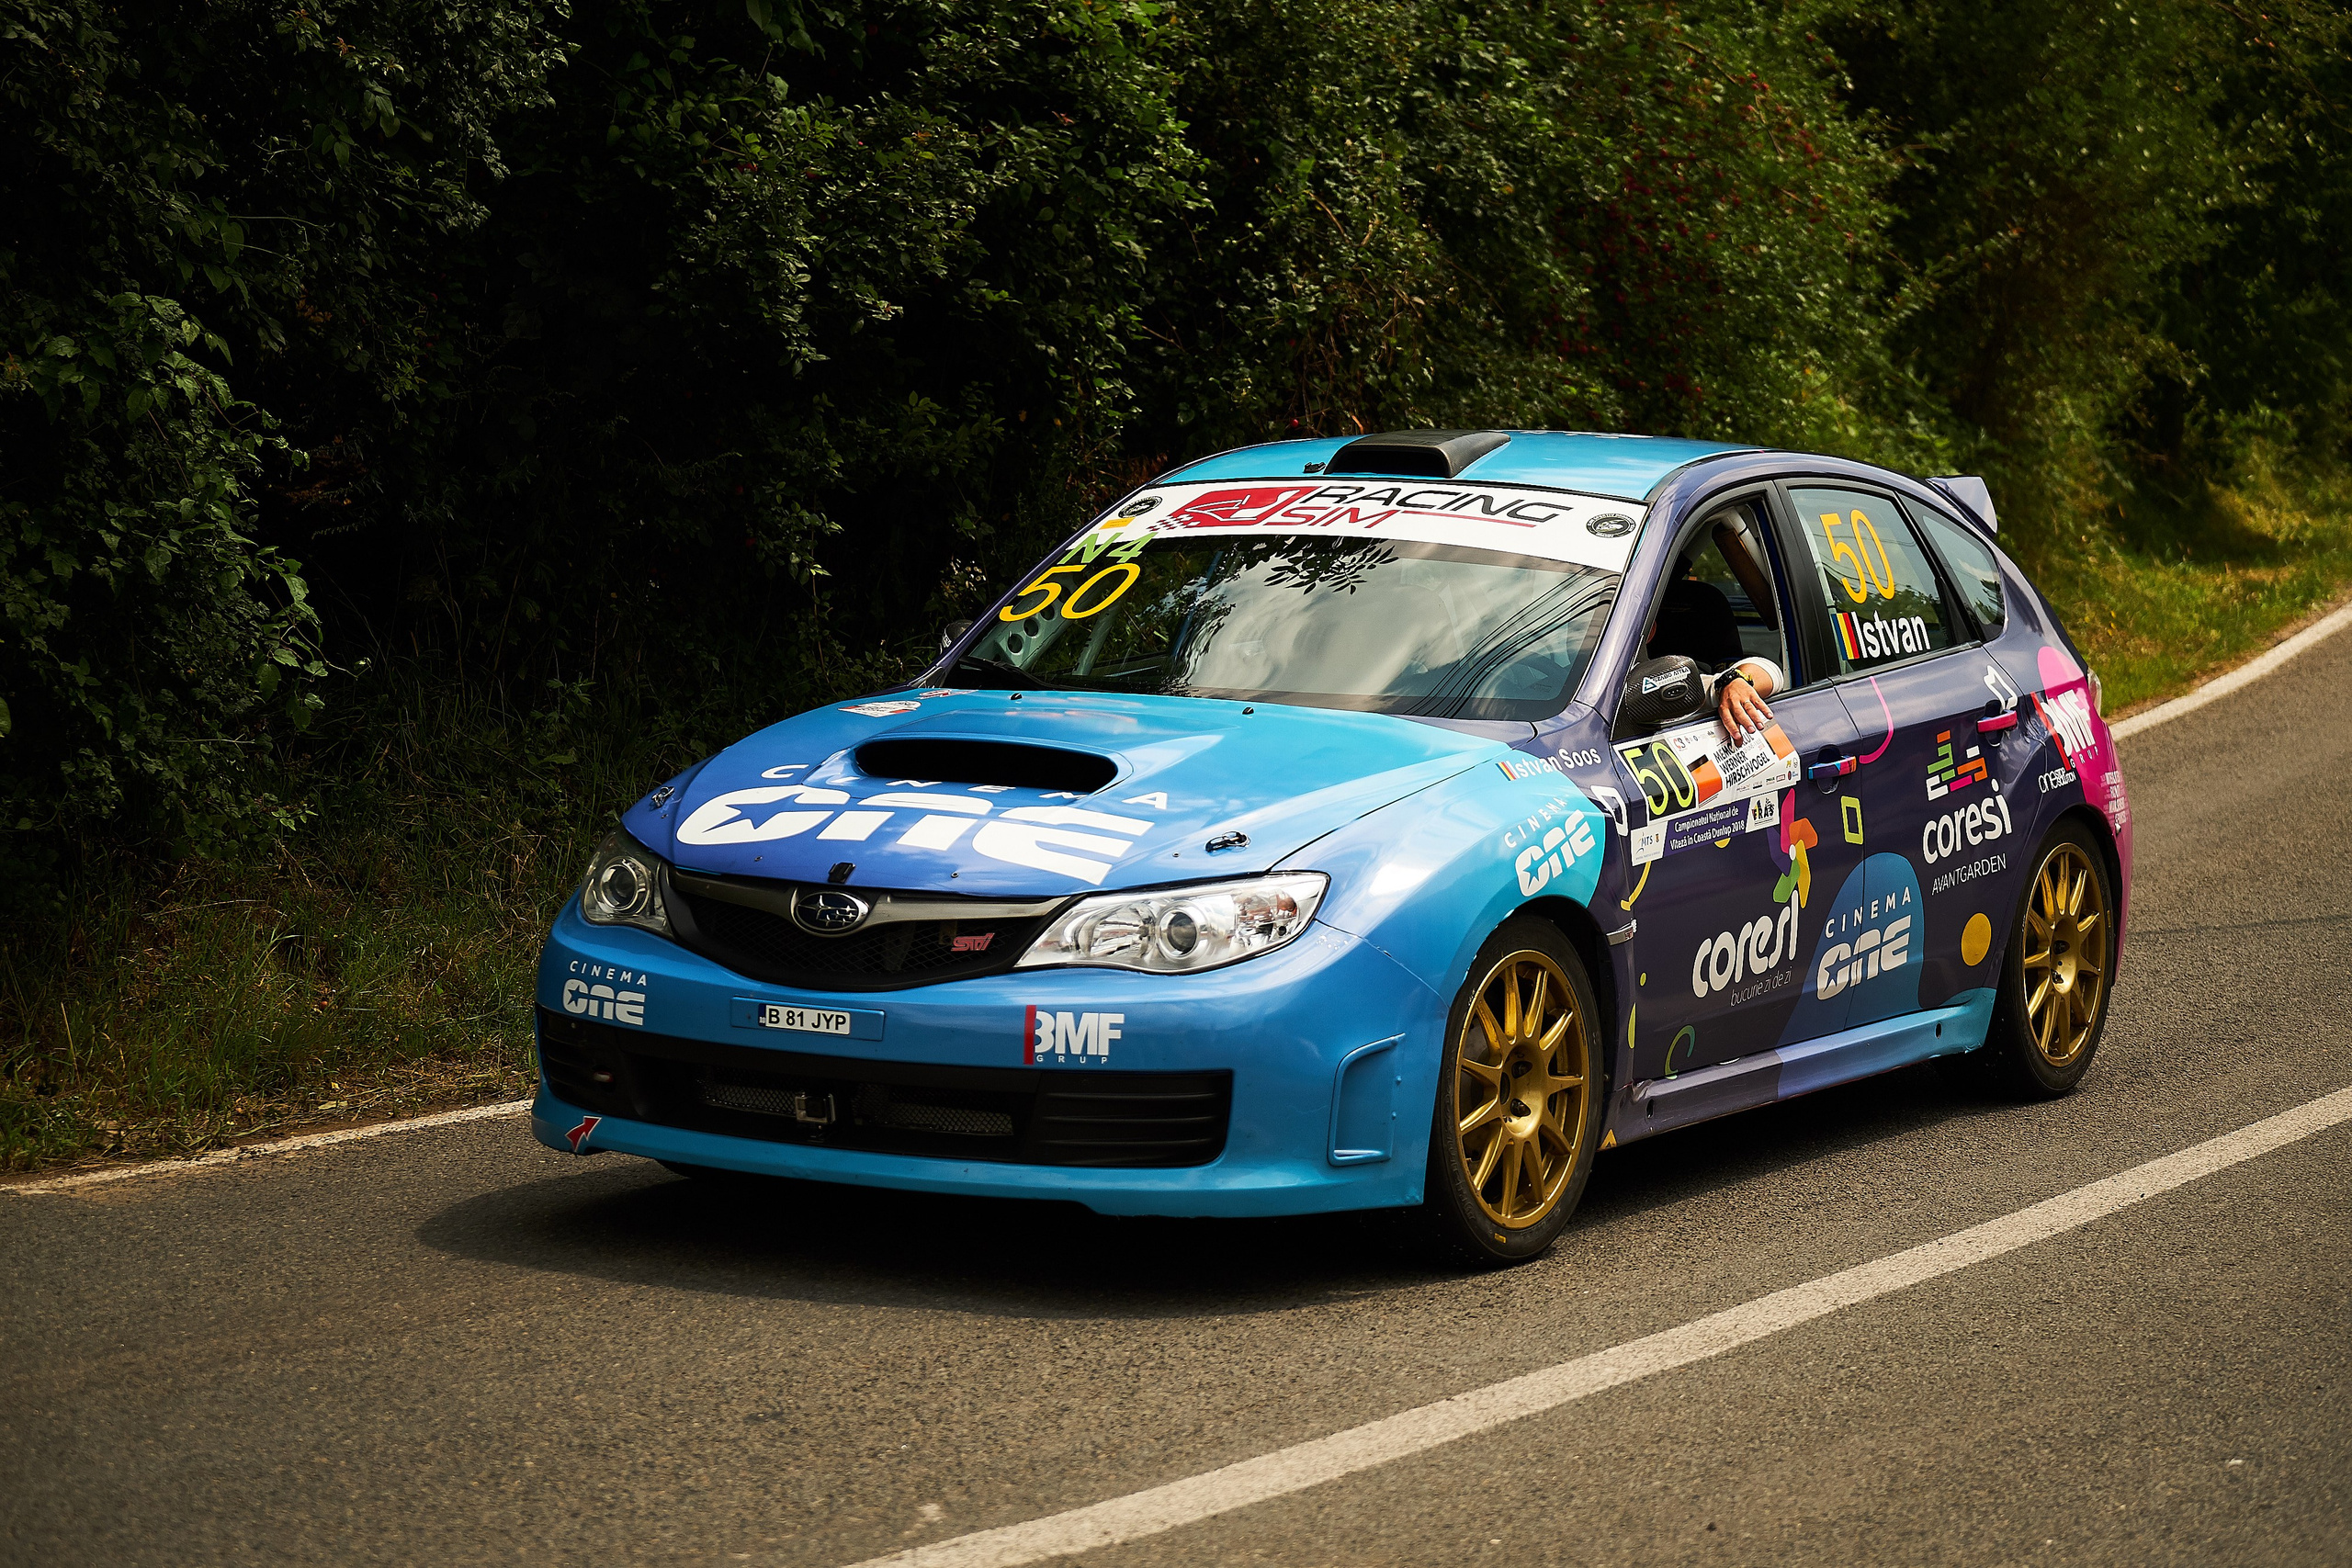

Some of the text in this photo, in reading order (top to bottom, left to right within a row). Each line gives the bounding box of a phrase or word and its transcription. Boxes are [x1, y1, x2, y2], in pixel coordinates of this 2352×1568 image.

[1265, 506, 1397, 528] SIM
[1300, 485, 1573, 524] RACING
[1057, 532, 1159, 564] N4
[1819, 509, 1895, 604] 50
[999, 563, 1140, 622] 50
[1850, 610, 1930, 659] Istvan
[1506, 748, 1601, 779] Istvan Soos
[1719, 750, 1748, 774] WERNER
[1725, 751, 1770, 788] HIRSCHVOGEL
[2070, 746, 2099, 769] GRUP
[761, 764, 1168, 810] CINEMA
[1623, 742, 1694, 815] 50
[1504, 796, 1569, 848] CINEMA
[1669, 834, 1688, 851] Viteză
[1693, 829, 1712, 843] Coastă
[1712, 825, 1731, 840] Dunlop
[1732, 820, 1745, 833] 2018
[1674, 816, 1709, 833] Campionatul
[1731, 806, 1738, 817] de
[1923, 779, 2012, 863] coresi
[1931, 853, 2007, 896] AVANTGARDEN
[1826, 886, 1911, 938] CINEMA
[1692, 890, 1799, 998] coresi
[570, 960, 647, 987] CINEMA
[1730, 966, 1792, 1007] bucurie zi de zi
[768, 1008, 780, 1024] B
[786, 1010, 804, 1027] 81
[811, 1012, 846, 1030] JYP
[1035, 1011, 1125, 1055] BMF
[1036, 1055, 1108, 1066] GRUP
